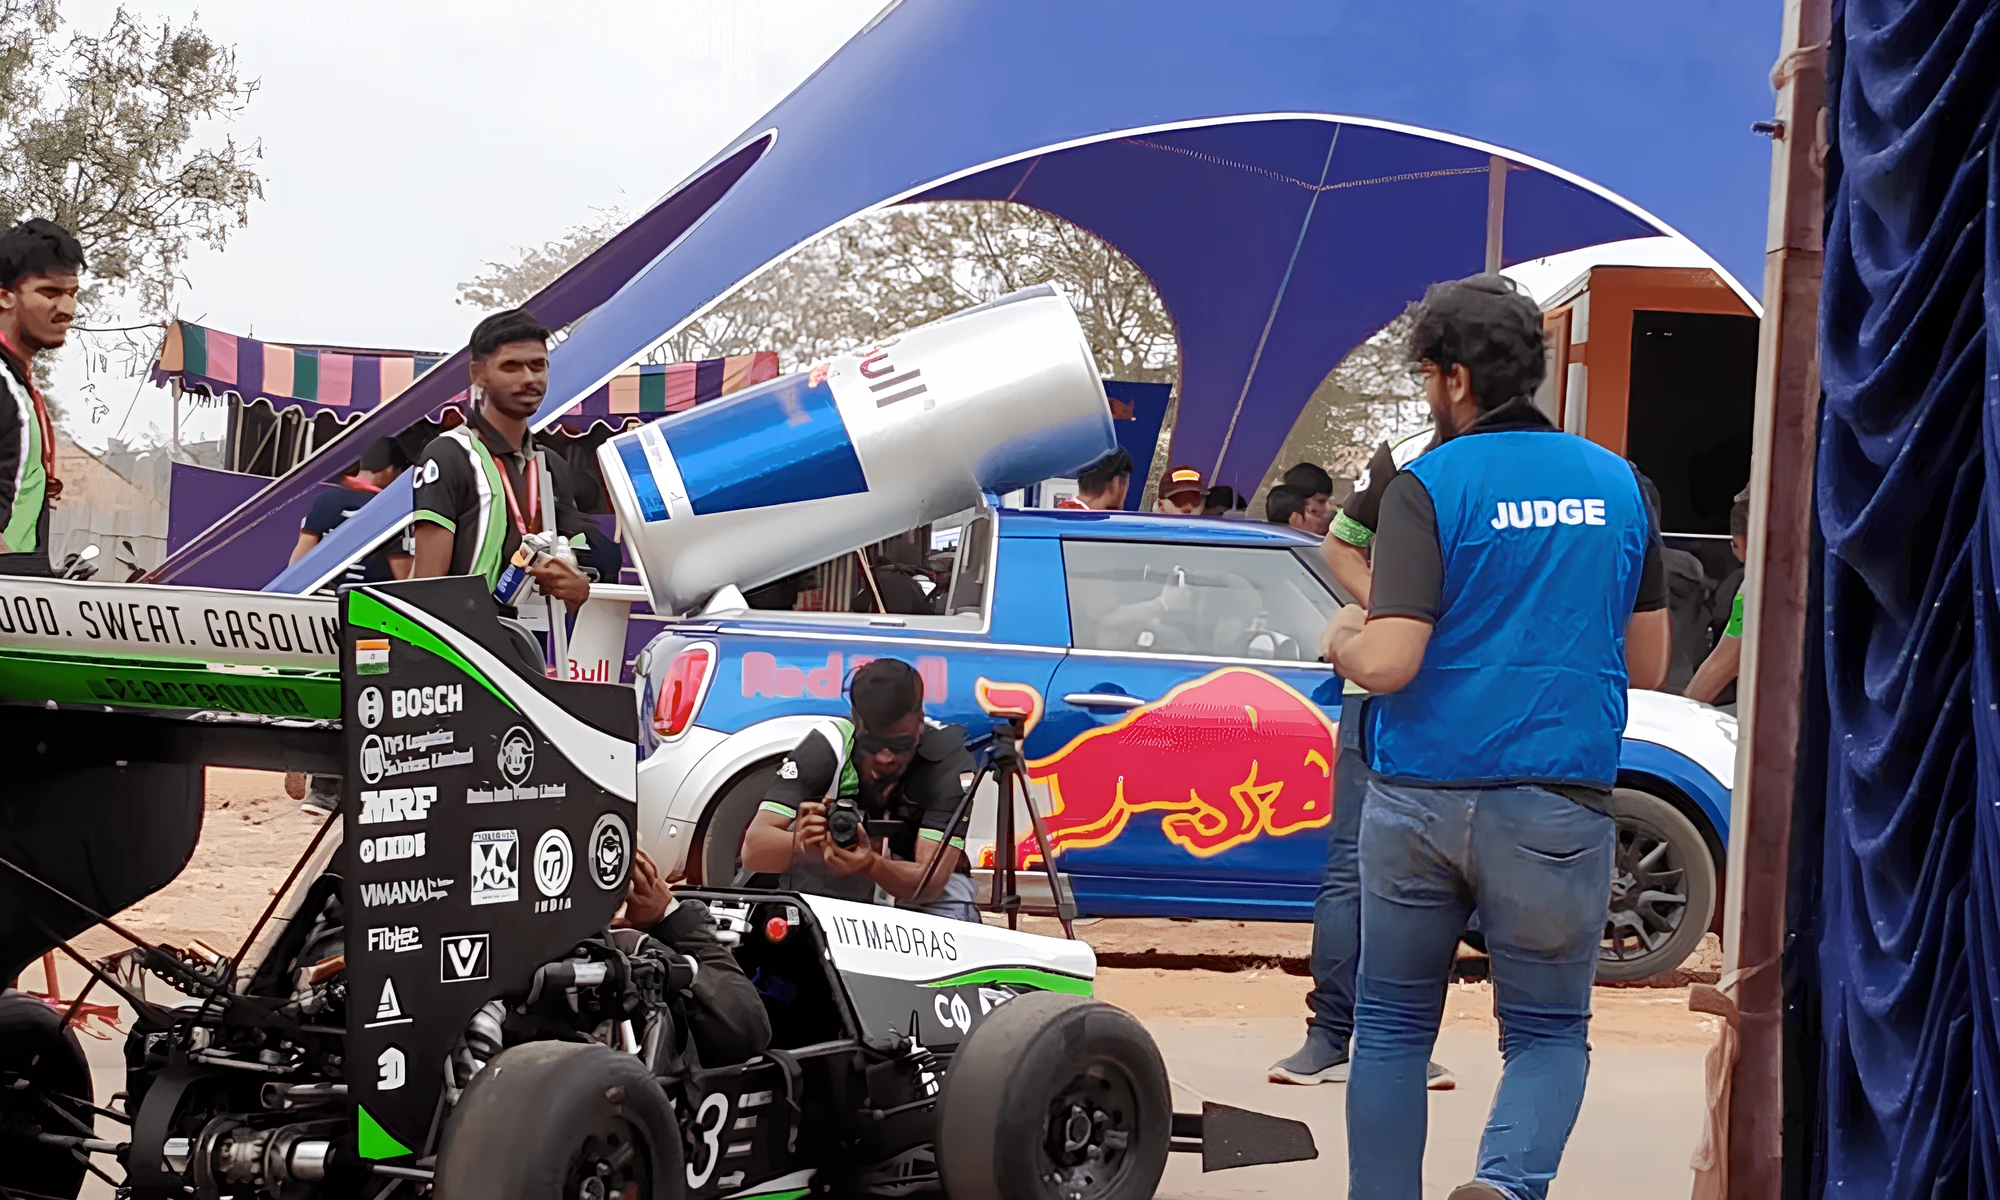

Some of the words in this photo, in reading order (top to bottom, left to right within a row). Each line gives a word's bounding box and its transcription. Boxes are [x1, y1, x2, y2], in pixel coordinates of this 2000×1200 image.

[860, 348, 928, 408] ull
[1491, 499, 1606, 530] JUDGE
[79, 600, 196, 645] SWEAT.
[391, 684, 463, 718] BOSCH
[358, 786, 437, 824] MRF
